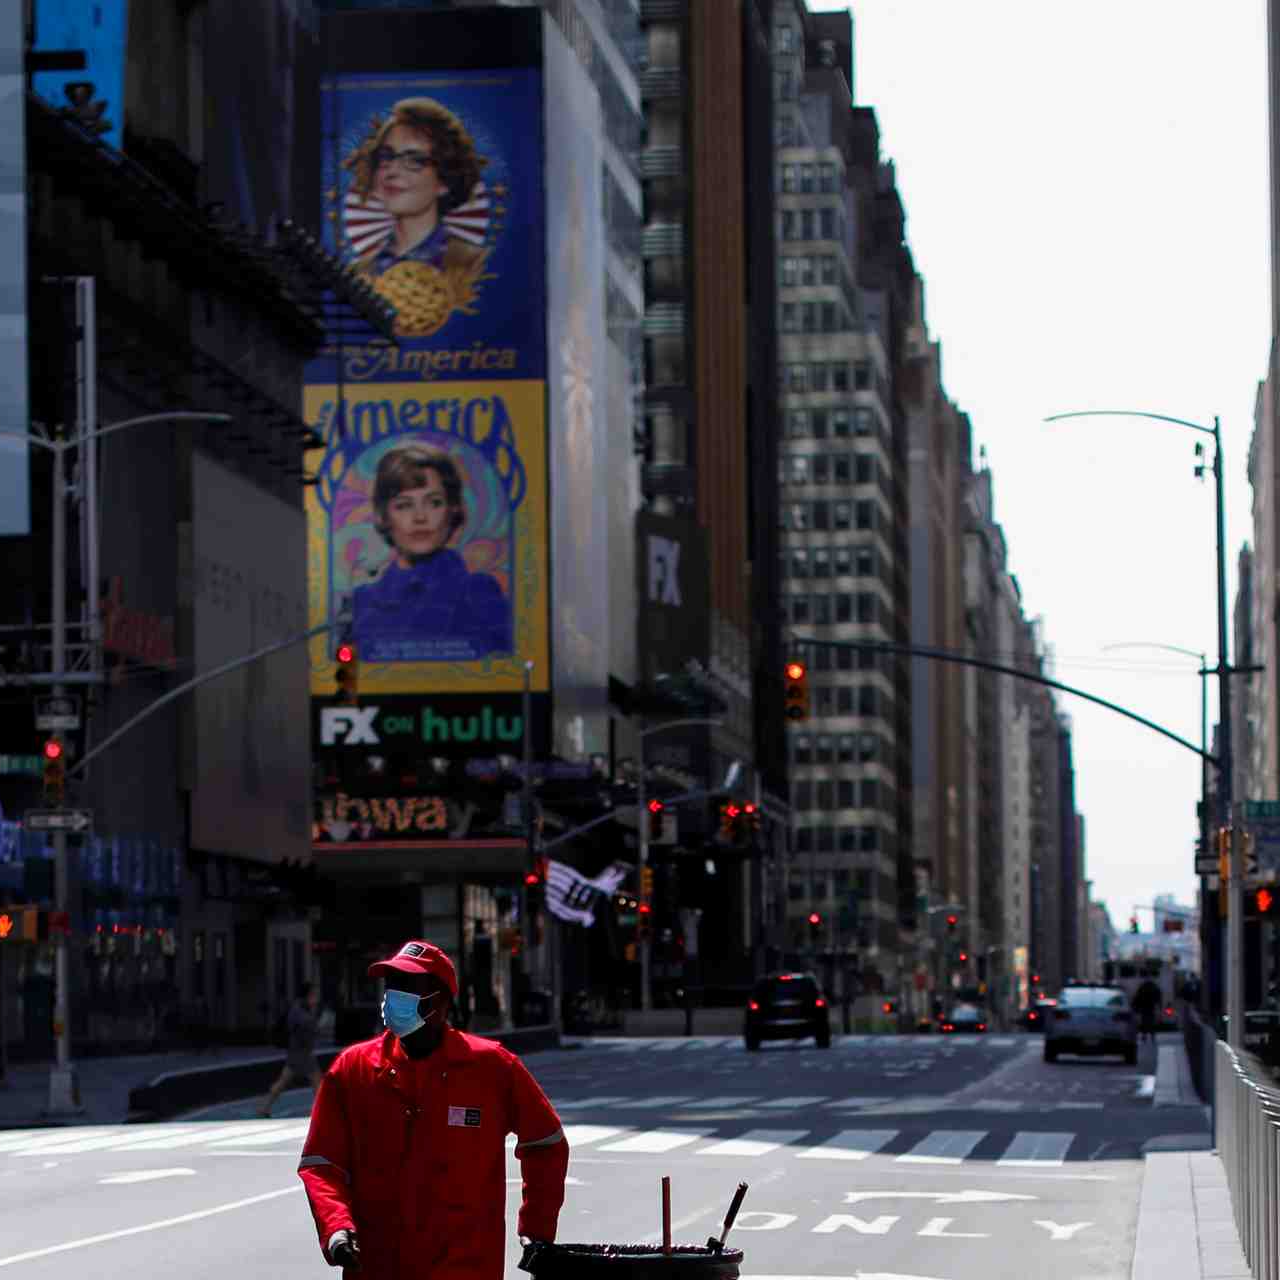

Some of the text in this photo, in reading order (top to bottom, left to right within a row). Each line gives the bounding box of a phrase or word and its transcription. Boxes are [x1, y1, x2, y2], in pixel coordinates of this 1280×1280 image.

[321, 706, 381, 746] FX
[423, 705, 524, 742] hulu
[731, 1210, 1095, 1241] ONLY
